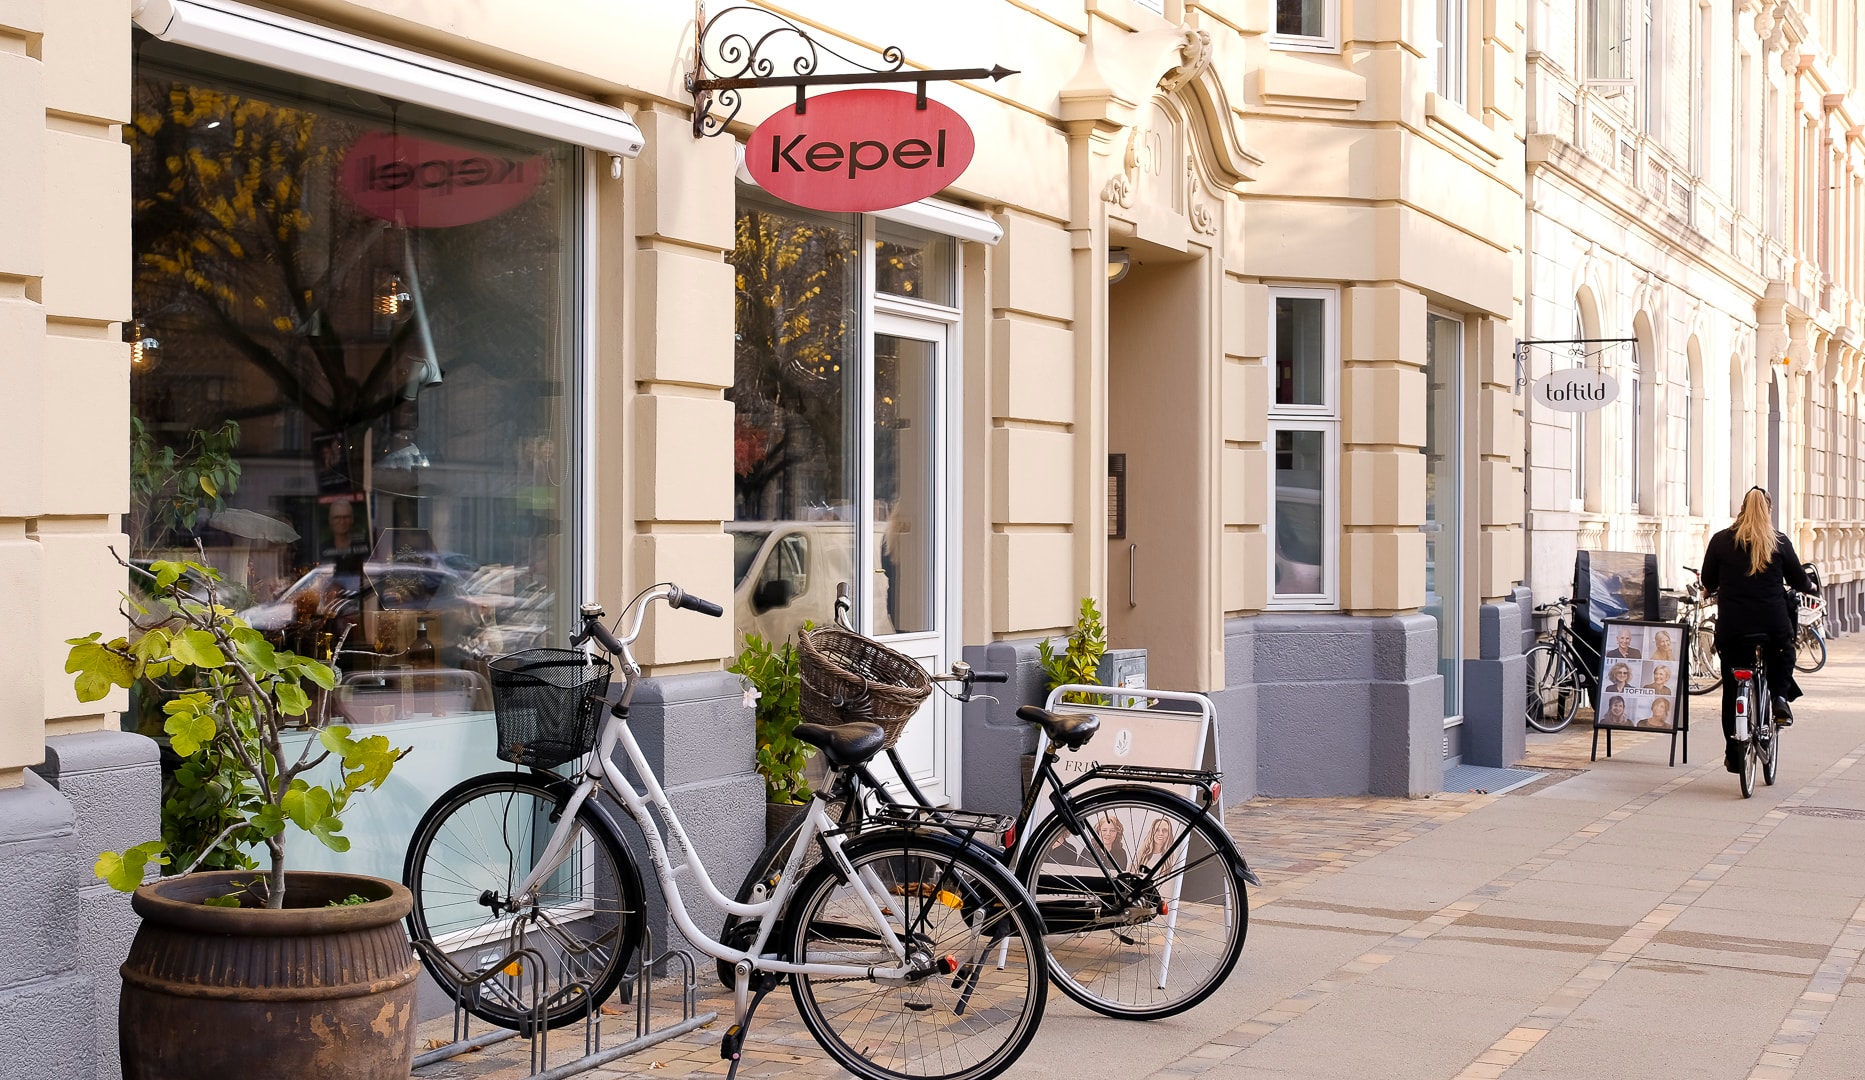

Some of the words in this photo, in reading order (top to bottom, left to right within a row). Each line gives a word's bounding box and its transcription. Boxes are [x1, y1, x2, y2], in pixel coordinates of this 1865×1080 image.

[771, 129, 946, 179] Kepel
[1546, 380, 1605, 402] toftild
[1065, 760, 1090, 773] FRI
